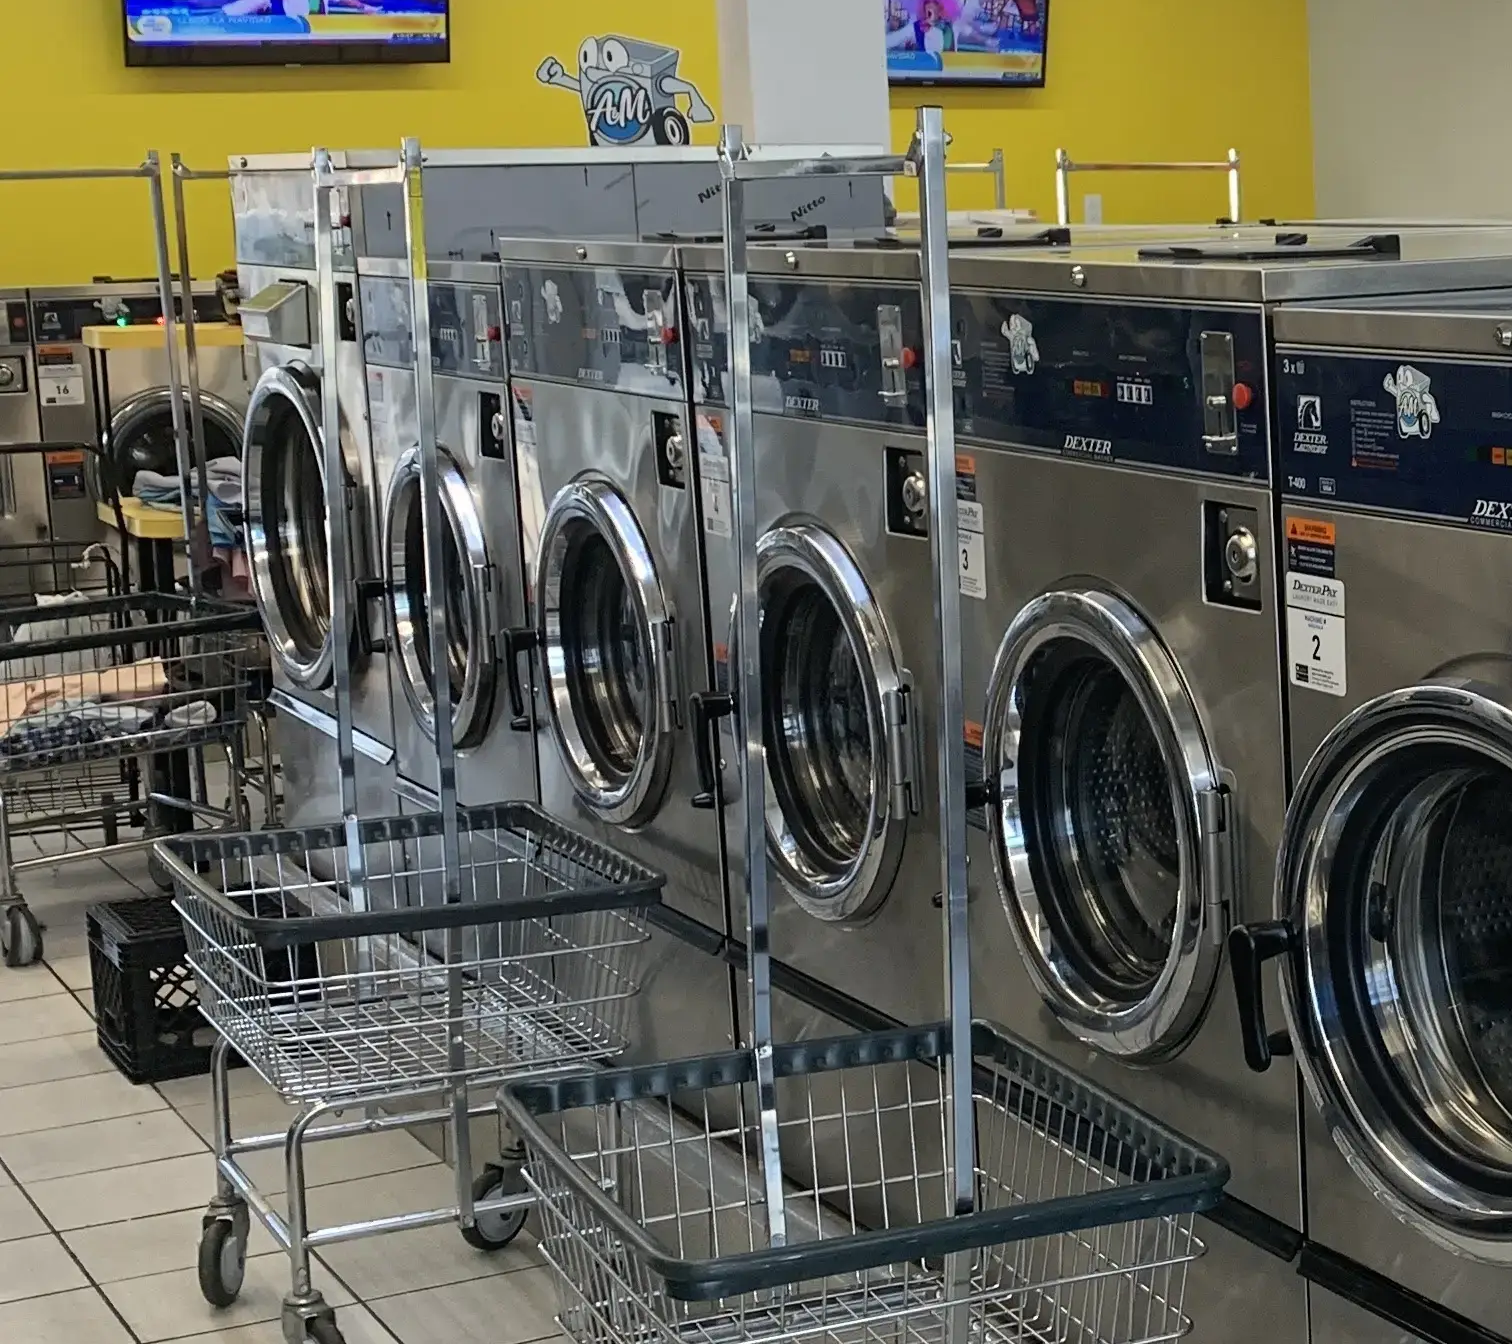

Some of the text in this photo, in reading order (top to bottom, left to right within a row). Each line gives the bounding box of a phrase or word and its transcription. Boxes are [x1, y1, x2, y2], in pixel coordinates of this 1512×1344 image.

[790, 195, 826, 222] Nitto
[1283, 358, 1290, 373] 3
[56, 385, 70, 395] 16
[785, 395, 820, 411] DEXTER
[1063, 434, 1112, 455] DEXTER
[962, 549, 969, 571] 3
[1311, 635, 1321, 661] 2
